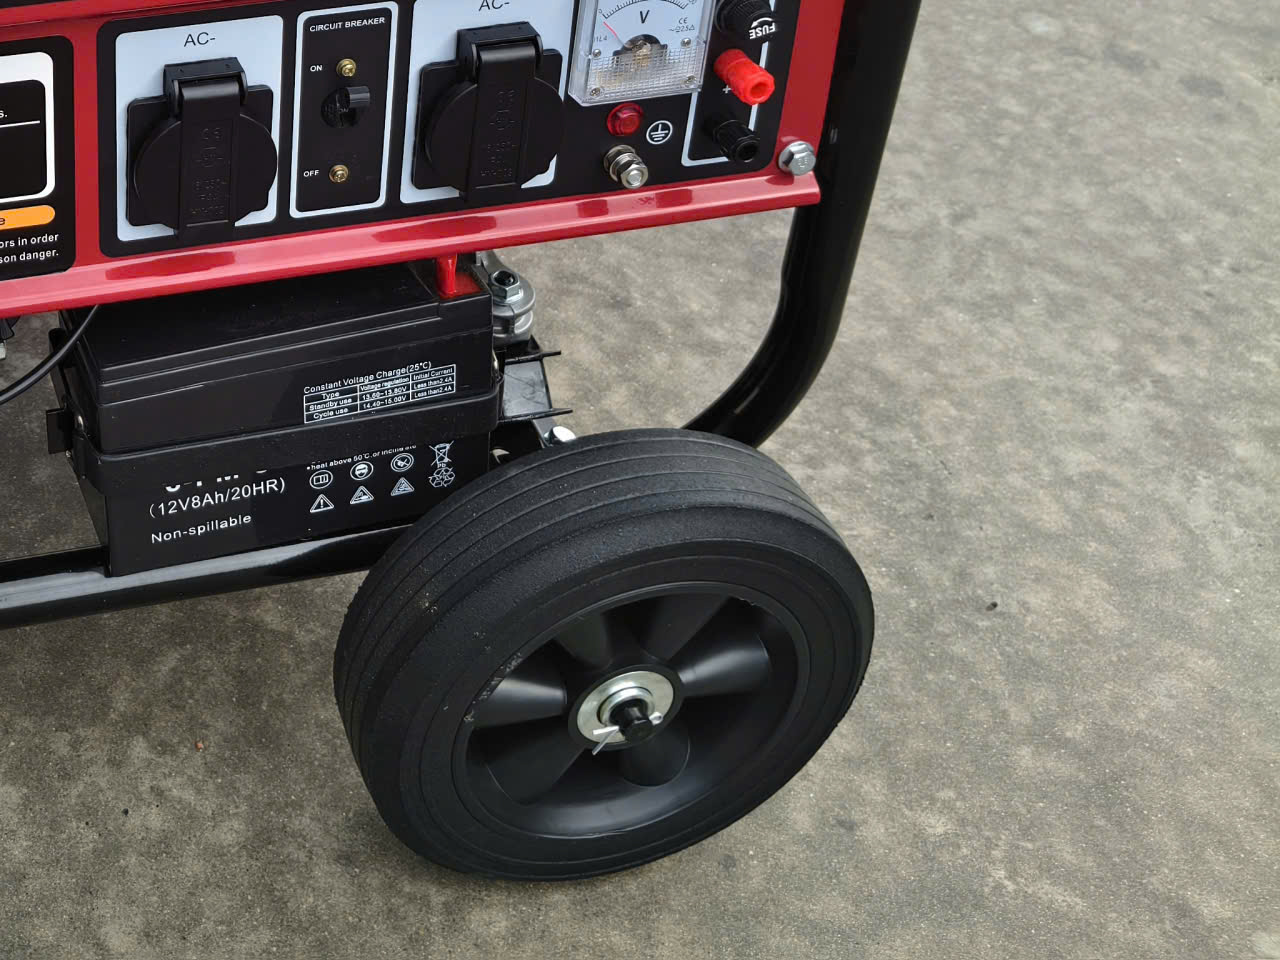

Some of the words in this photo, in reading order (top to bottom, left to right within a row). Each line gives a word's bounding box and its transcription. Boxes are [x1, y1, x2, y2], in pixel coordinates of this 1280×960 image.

[640, 10, 650, 24] V
[309, 21, 343, 32] CIRCUIT
[344, 17, 386, 28] BREAKER
[748, 22, 776, 39] FUSE
[303, 170, 320, 178] OFF
[18, 237, 28, 246] in
[30, 233, 59, 244] order
[19, 248, 59, 262] danger.
[413, 372, 430, 381] Initial
[430, 367, 453, 377] Current
[303, 380, 342, 394] Constant
[342, 373, 374, 386] Voltage
[360, 382, 380, 391] Voltage
[381, 377, 410, 389] regulation
[413, 382, 427, 390] Less
[321, 390, 340, 400] Type
[414, 390, 427, 398] Less
[309, 398, 338, 411] Standby
[313, 409, 334, 420] Cycle
[329, 457, 352, 467] above
[149, 477, 286, 519] (12V8Ah/20HR)
[151, 514, 252, 544] Non-spillable
